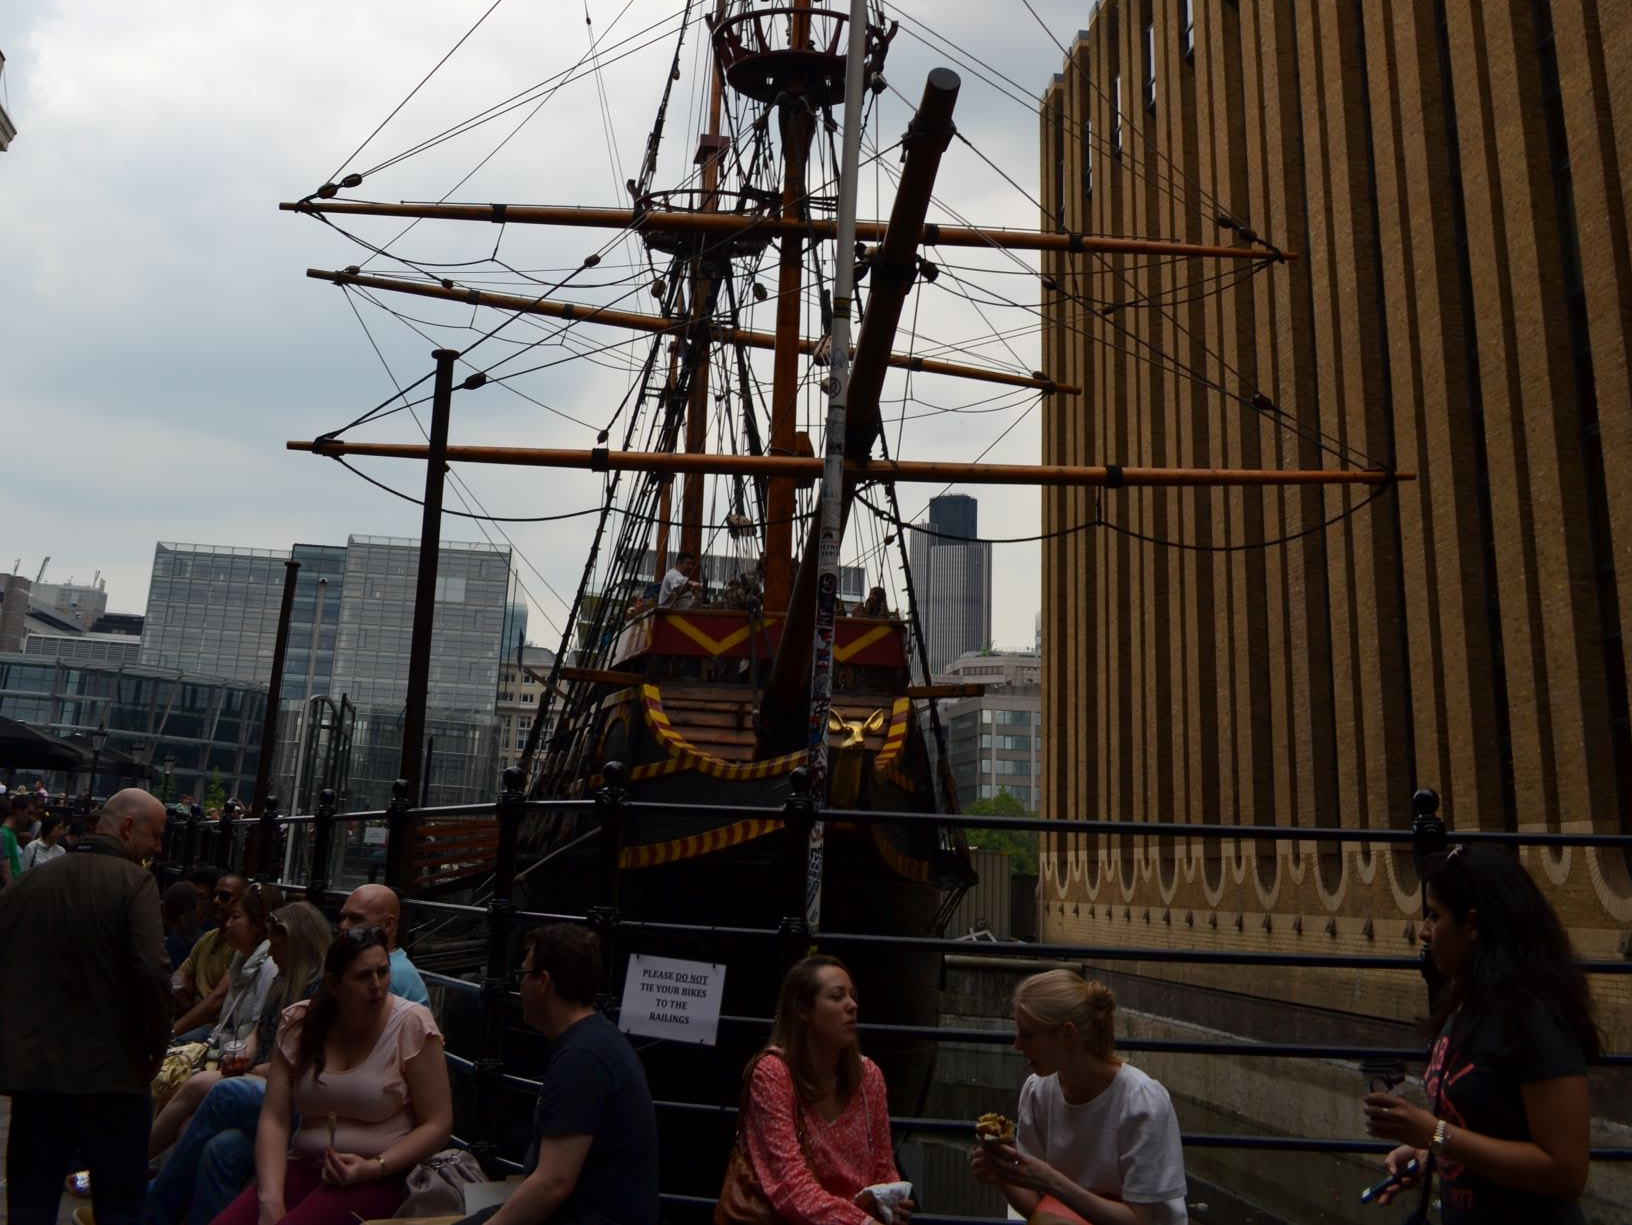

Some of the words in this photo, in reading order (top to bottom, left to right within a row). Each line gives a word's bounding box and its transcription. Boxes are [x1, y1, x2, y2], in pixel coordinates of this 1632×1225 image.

[643, 969, 674, 980] PLEASE
[675, 973, 688, 982] DO
[691, 975, 709, 984] NOT
[640, 983, 655, 992] TIE
[656, 985, 680, 995] YOUR
[682, 987, 707, 997] BIKES
[656, 999, 668, 1007] TO
[670, 1000, 688, 1009] THE
[649, 1012, 690, 1024] RAILINGS
